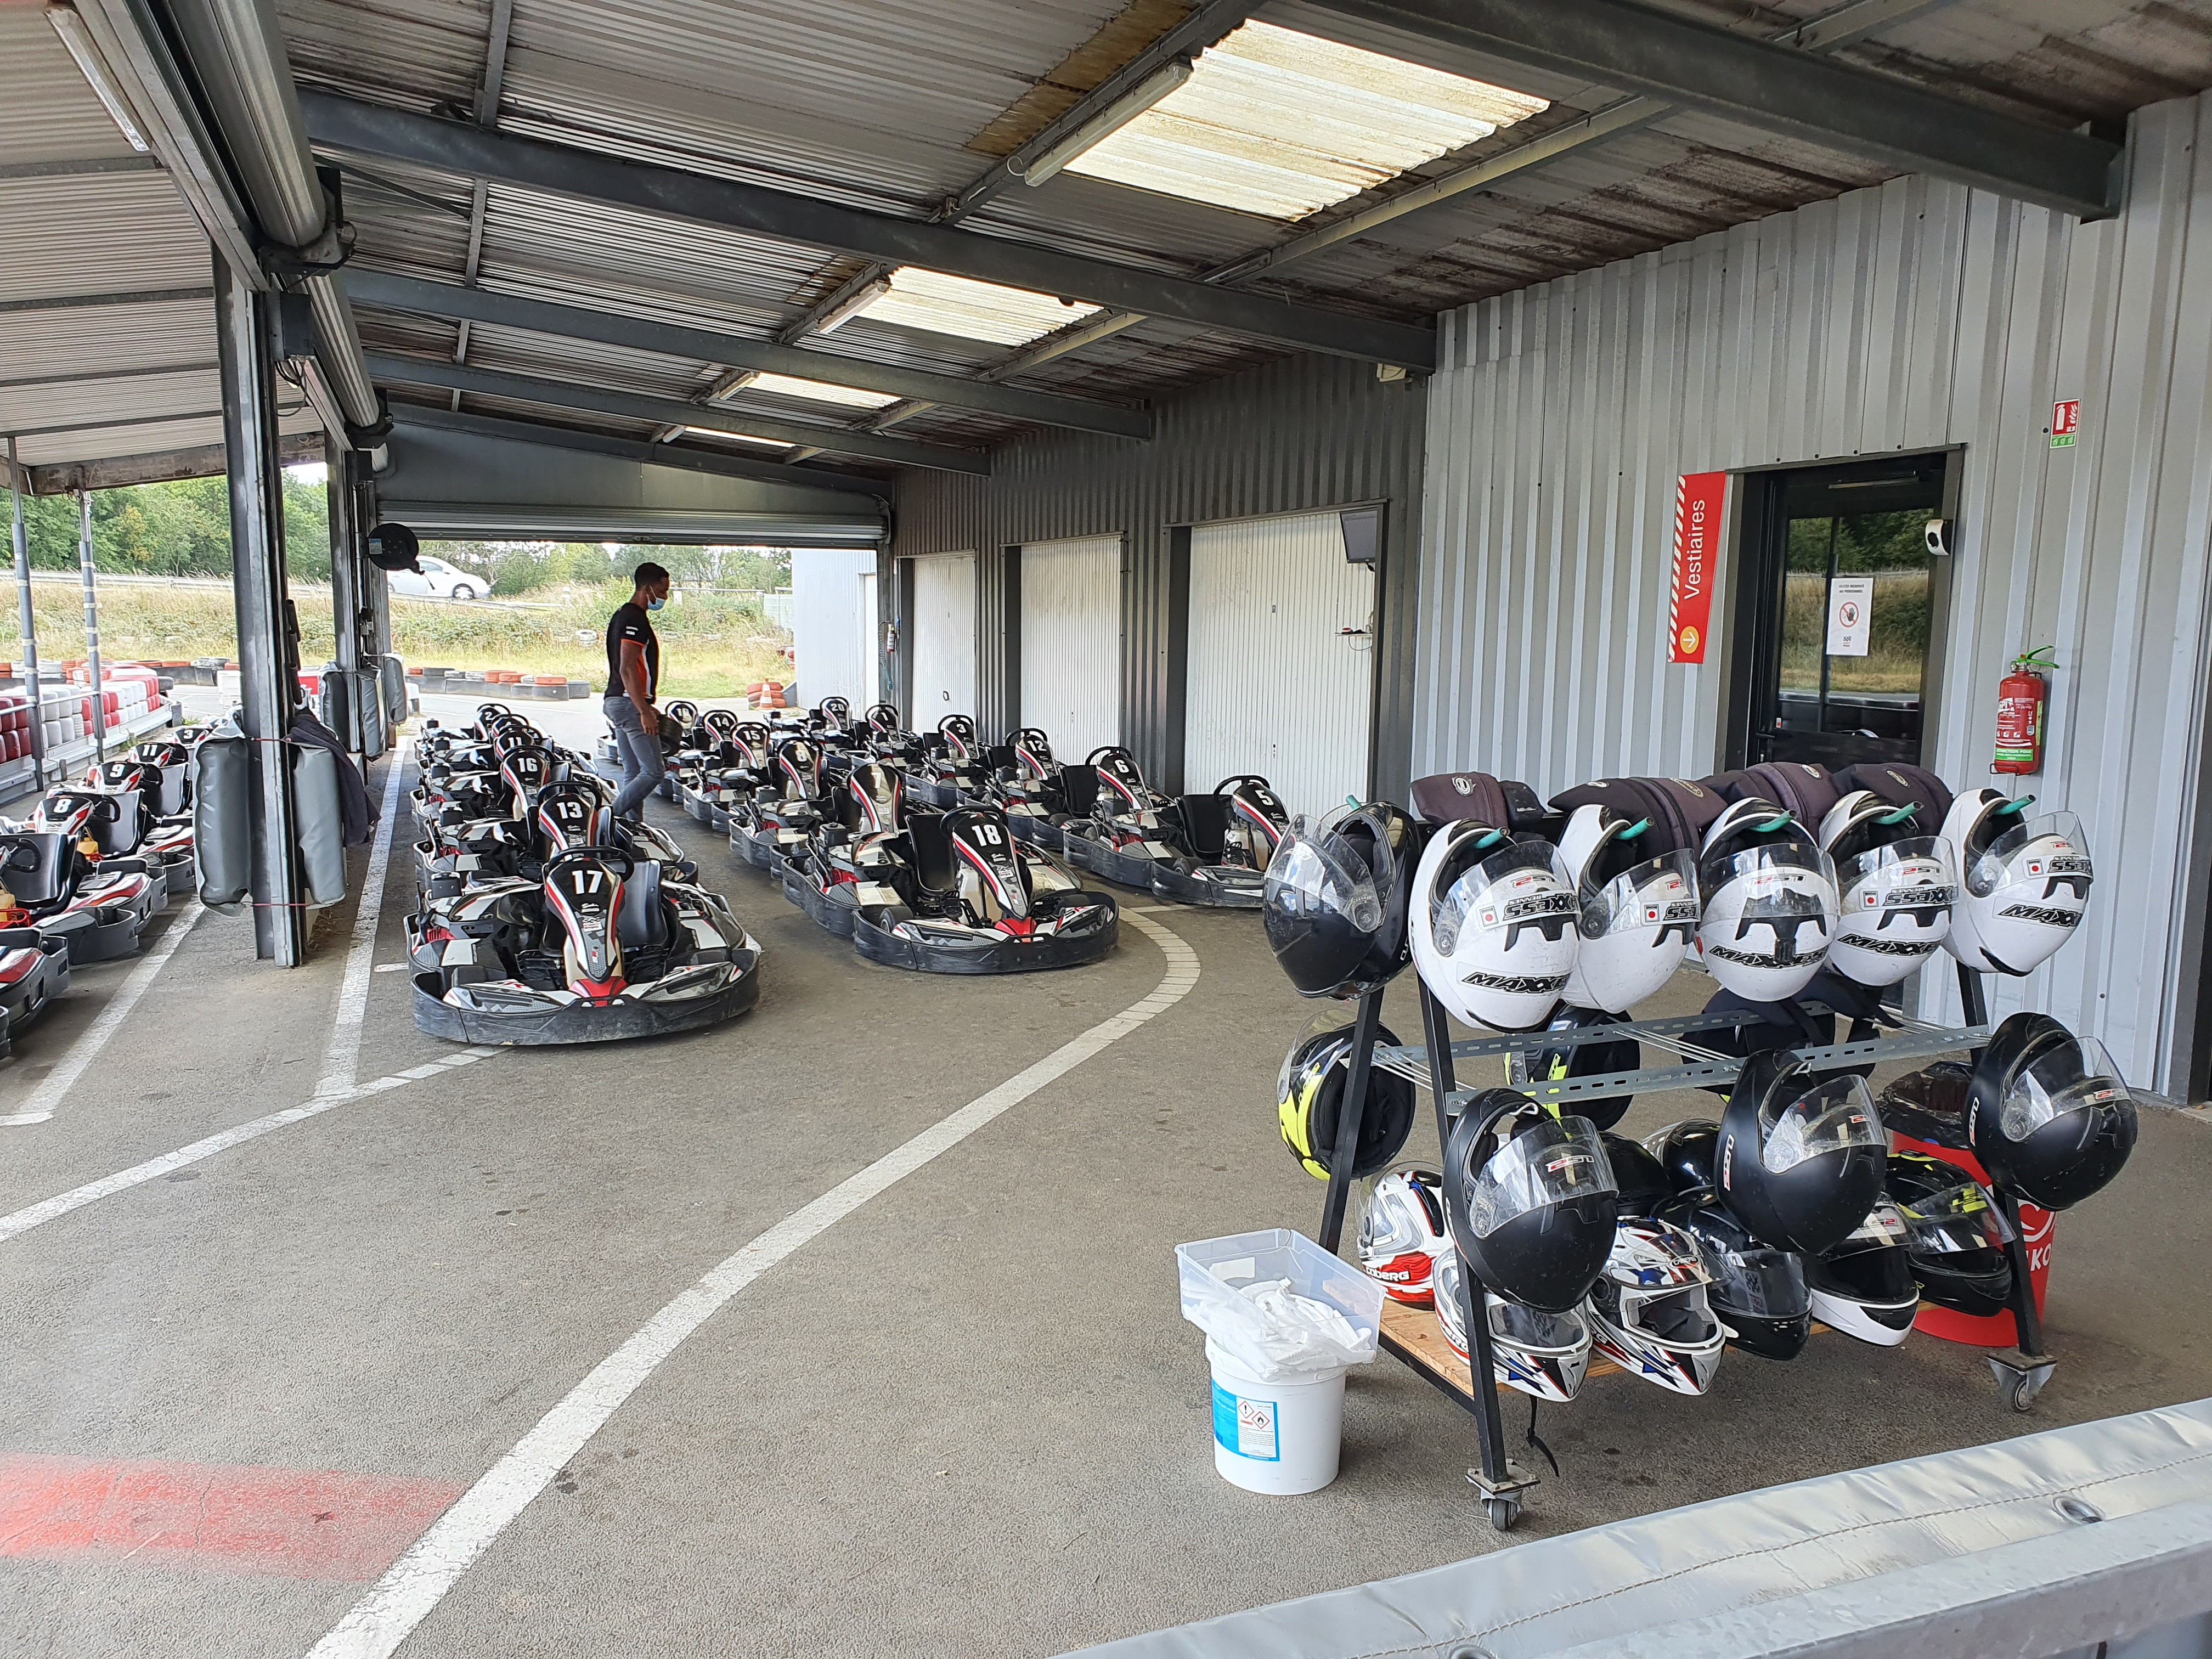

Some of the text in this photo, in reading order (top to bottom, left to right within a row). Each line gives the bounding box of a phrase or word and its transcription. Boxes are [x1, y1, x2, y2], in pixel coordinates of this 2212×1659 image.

[1684, 498, 1705, 600] Vestiaires
[830, 703, 845, 712] 20
[485, 712, 494, 720] 2
[714, 717, 730, 727] 14
[881, 712, 888, 721] 1
[183, 730, 194, 739] 3
[956, 724, 967, 733] 3
[743, 730, 761, 740] 15
[508, 737, 522, 748] 11
[1027, 740, 1047, 752] 12
[142, 744, 158, 756] 11
[795, 750, 808, 762] 8
[110, 764, 125, 777] 9
[517, 758, 538, 772] 16
[1114, 759, 1130, 773] 6
[871, 772, 882, 788] 7
[1255, 790, 1274, 805] 5
[53, 798, 72, 813] 8
[556, 802, 583, 819] 13
[971, 825, 1002, 847] 18
[1901, 867, 1941, 876] LS2
[572, 870, 603, 894] 17
[1753, 874, 1807, 885] LS2
[1509, 895, 1543, 906] RENNES
[1545, 1155, 1595, 1173] LS2
[1723, 1133, 1734, 1192] LS2
